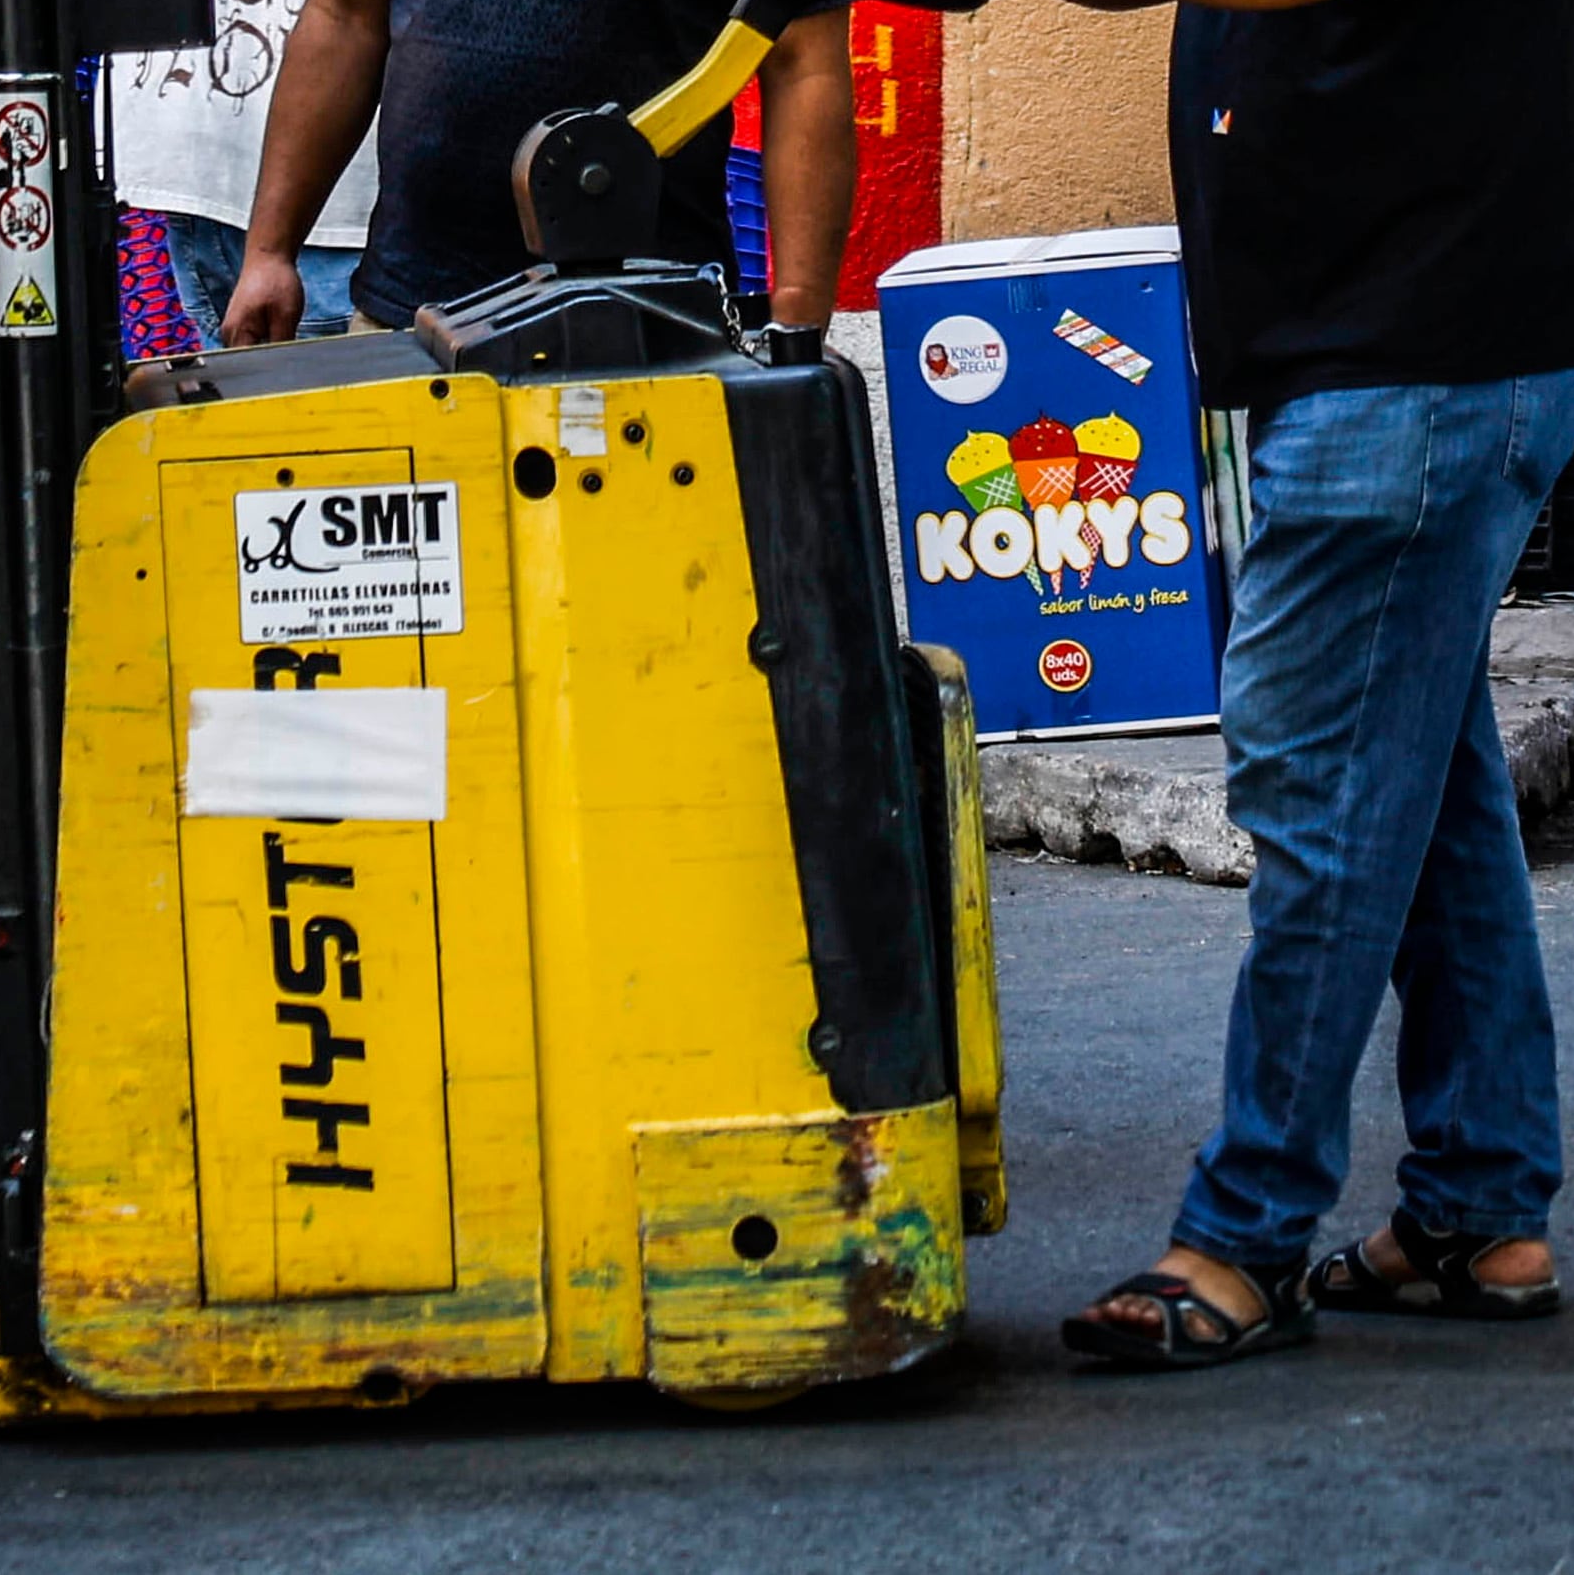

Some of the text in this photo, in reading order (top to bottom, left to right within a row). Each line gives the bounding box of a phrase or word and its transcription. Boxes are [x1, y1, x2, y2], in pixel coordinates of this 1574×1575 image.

[950, 345, 982, 361] KING
[958, 360, 1002, 374] REGAL
[320, 491, 448, 548] SMT
[915, 490, 1192, 584] KOKYS
[250, 580, 451, 604] CARRETILLAS ELEVADORAS
[1039, 587, 1189, 615] sabor limón y fresa
[1045, 651, 1084, 669] 8x40
[1052, 669, 1081, 682] uds.
